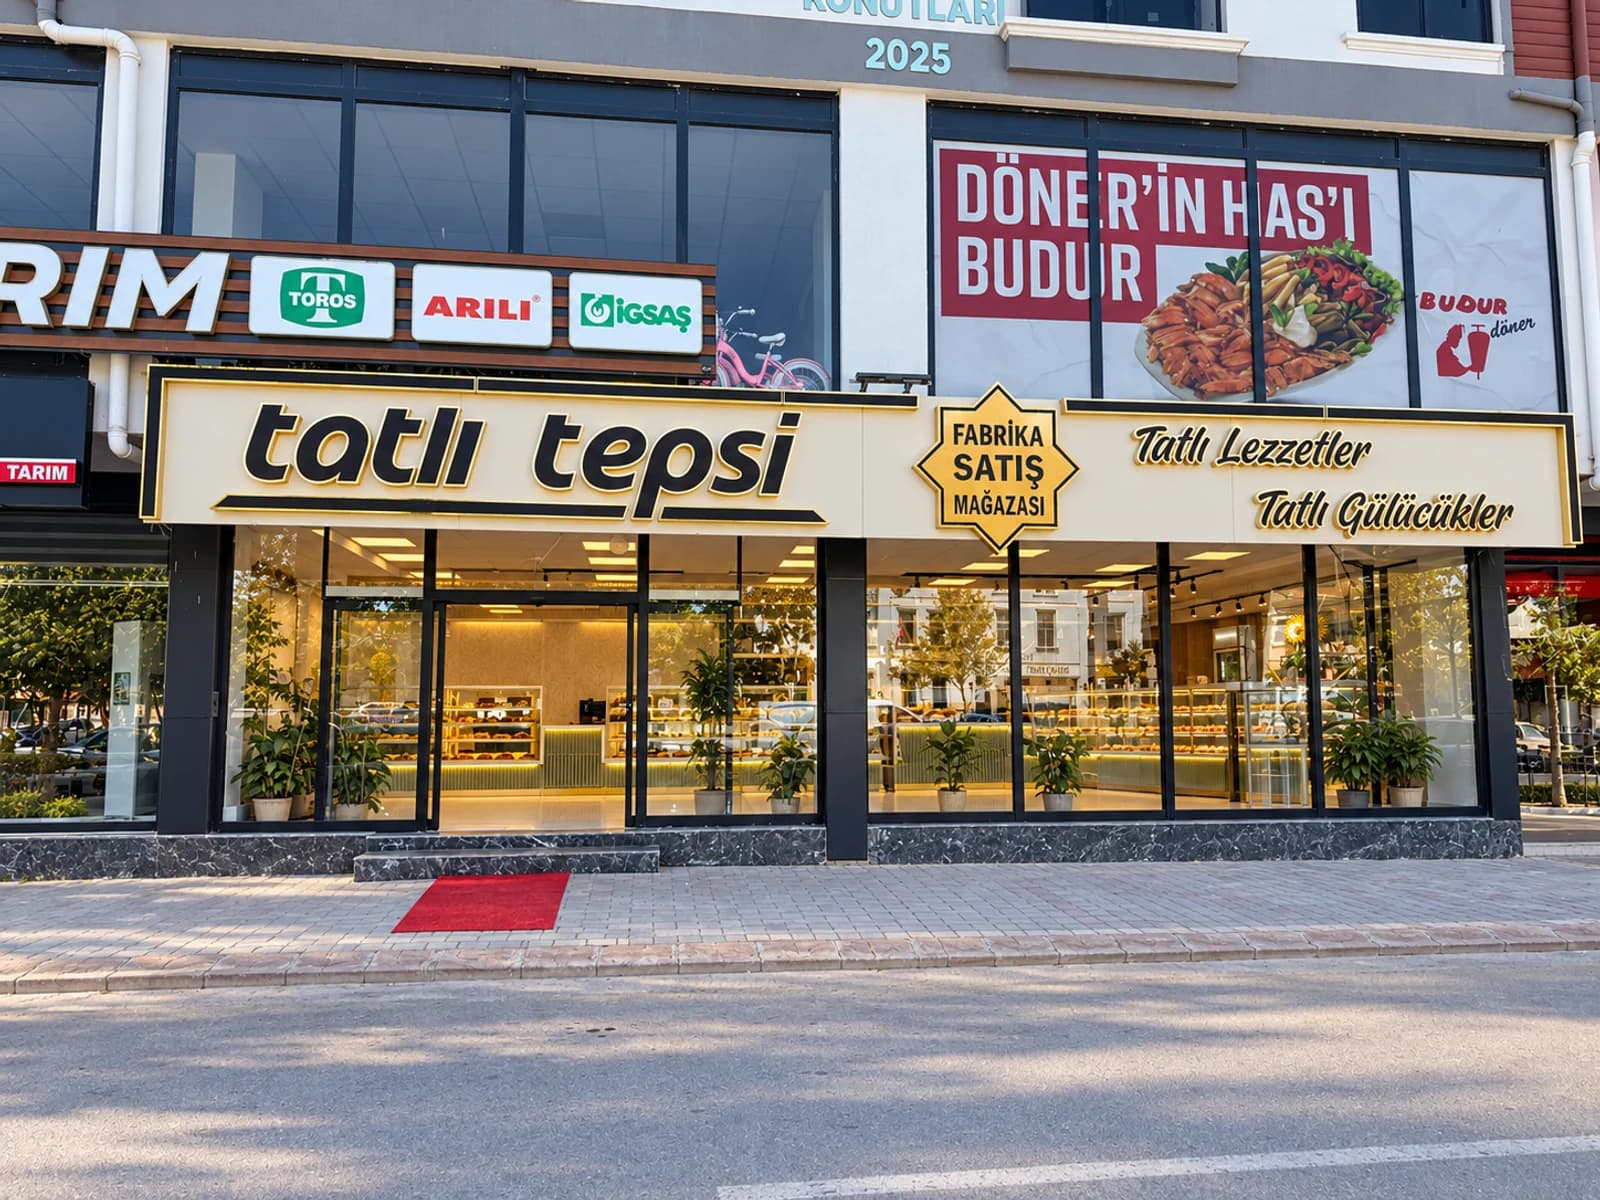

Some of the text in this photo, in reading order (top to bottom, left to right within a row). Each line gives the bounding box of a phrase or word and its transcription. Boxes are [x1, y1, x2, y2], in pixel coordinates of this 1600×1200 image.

[866, 37, 951, 75] 2025
[958, 236, 1143, 302] BUDUR
[288, 291, 357, 309] TOROS
[1420, 292, 1508, 315] BUDUR
[1490, 318, 1536, 339] döner
[953, 419, 1044, 447] FABRİKA
[1133, 425, 1372, 469] Tatlı Lezzetler
[7, 464, 68, 480] TARIM
[243, 402, 803, 520] tatlı tepsi
[953, 453, 1044, 490] SATIŞ
[954, 489, 1045, 516] MAĞAZASI
[1256, 489, 1514, 538] Tatlı Gülücükler
